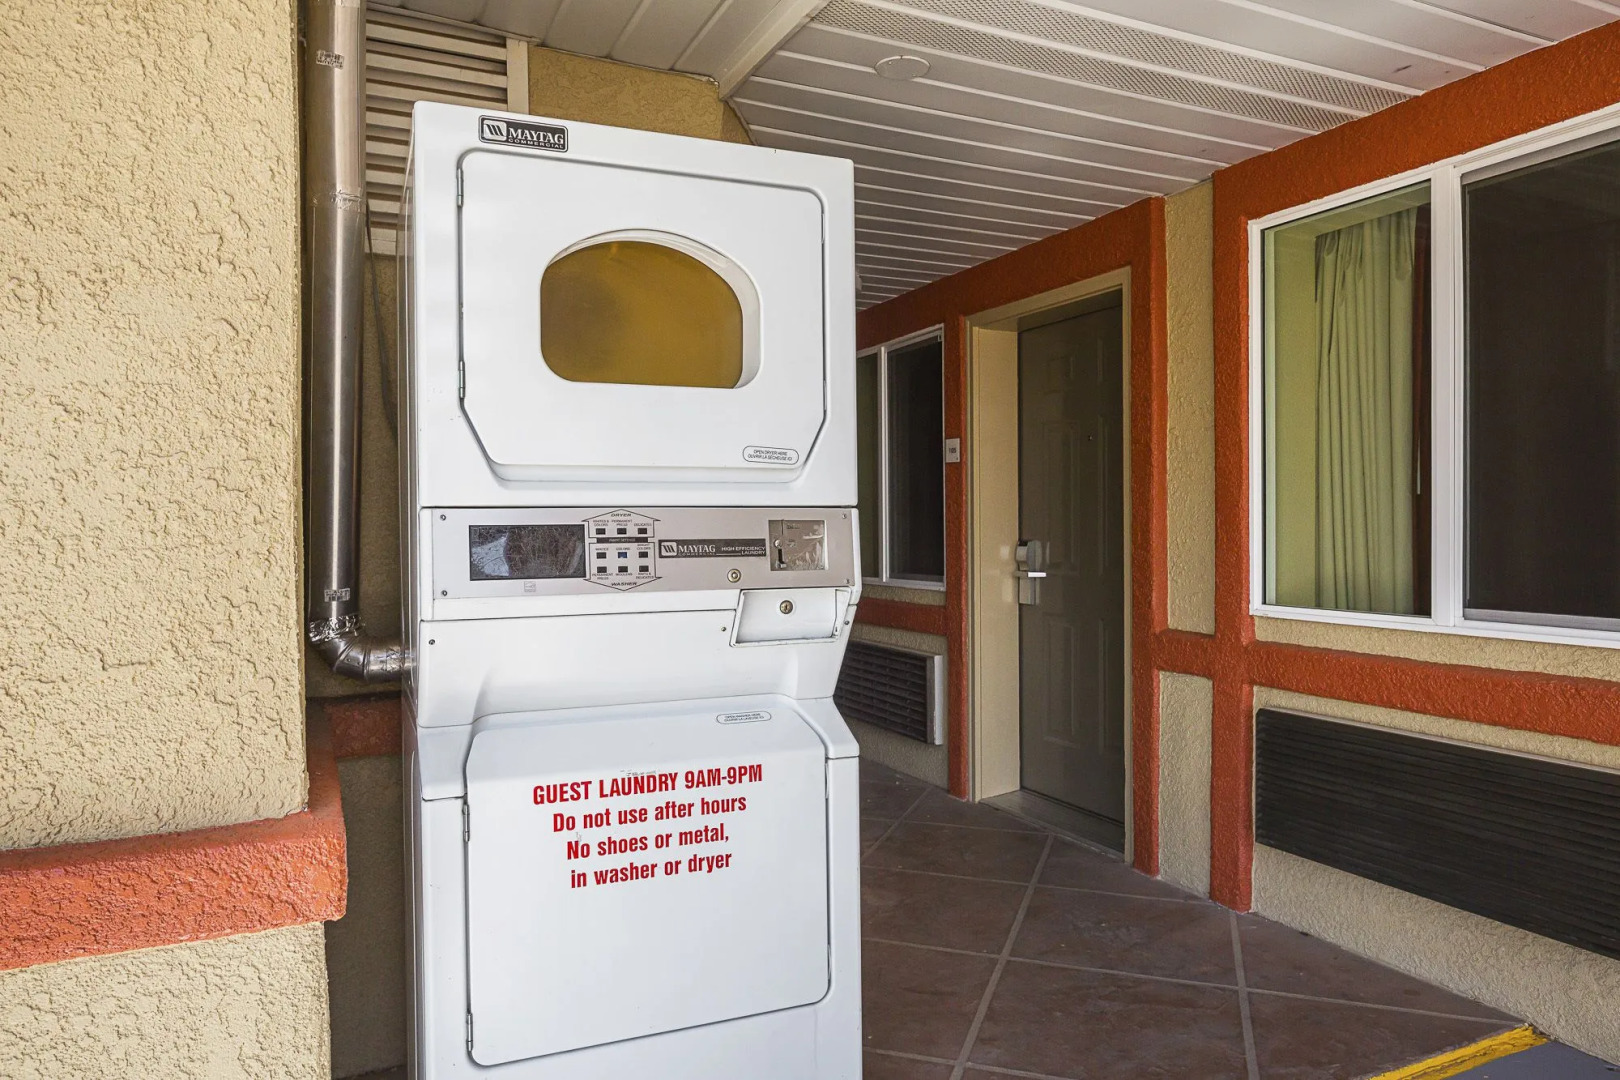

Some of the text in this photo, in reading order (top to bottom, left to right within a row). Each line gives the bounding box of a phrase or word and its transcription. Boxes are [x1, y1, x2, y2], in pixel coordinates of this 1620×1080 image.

[508, 127, 564, 144] MAYTAG
[508, 138, 564, 149] COMMERCIAL
[678, 544, 716, 553] MAYTAG
[533, 764, 763, 805] GUEST LAUNDRY 9AM-9PM
[553, 796, 747, 832] Do not use after hours
[567, 823, 729, 860] No shoes or metal,
[570, 853, 732, 888] in washer or dryer
